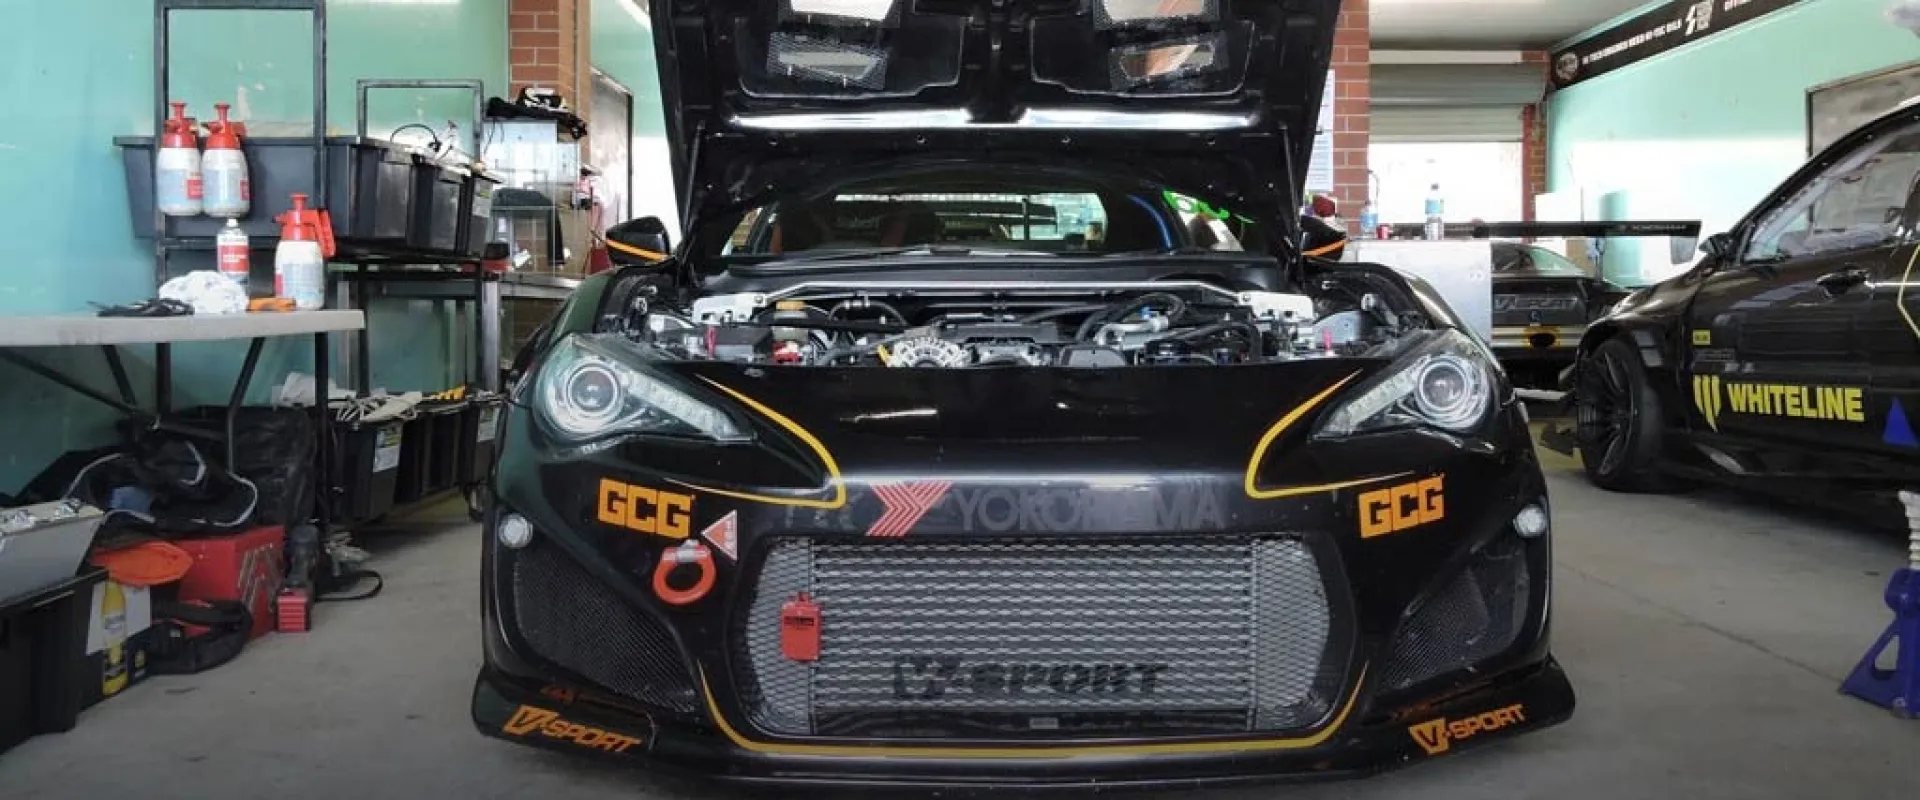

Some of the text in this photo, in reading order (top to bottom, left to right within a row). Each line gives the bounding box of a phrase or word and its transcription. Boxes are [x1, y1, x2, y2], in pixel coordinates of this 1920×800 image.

[1726, 384, 1864, 422] WHITELINE
[598, 478, 691, 538] GCG
[1359, 476, 1444, 538] GCG
